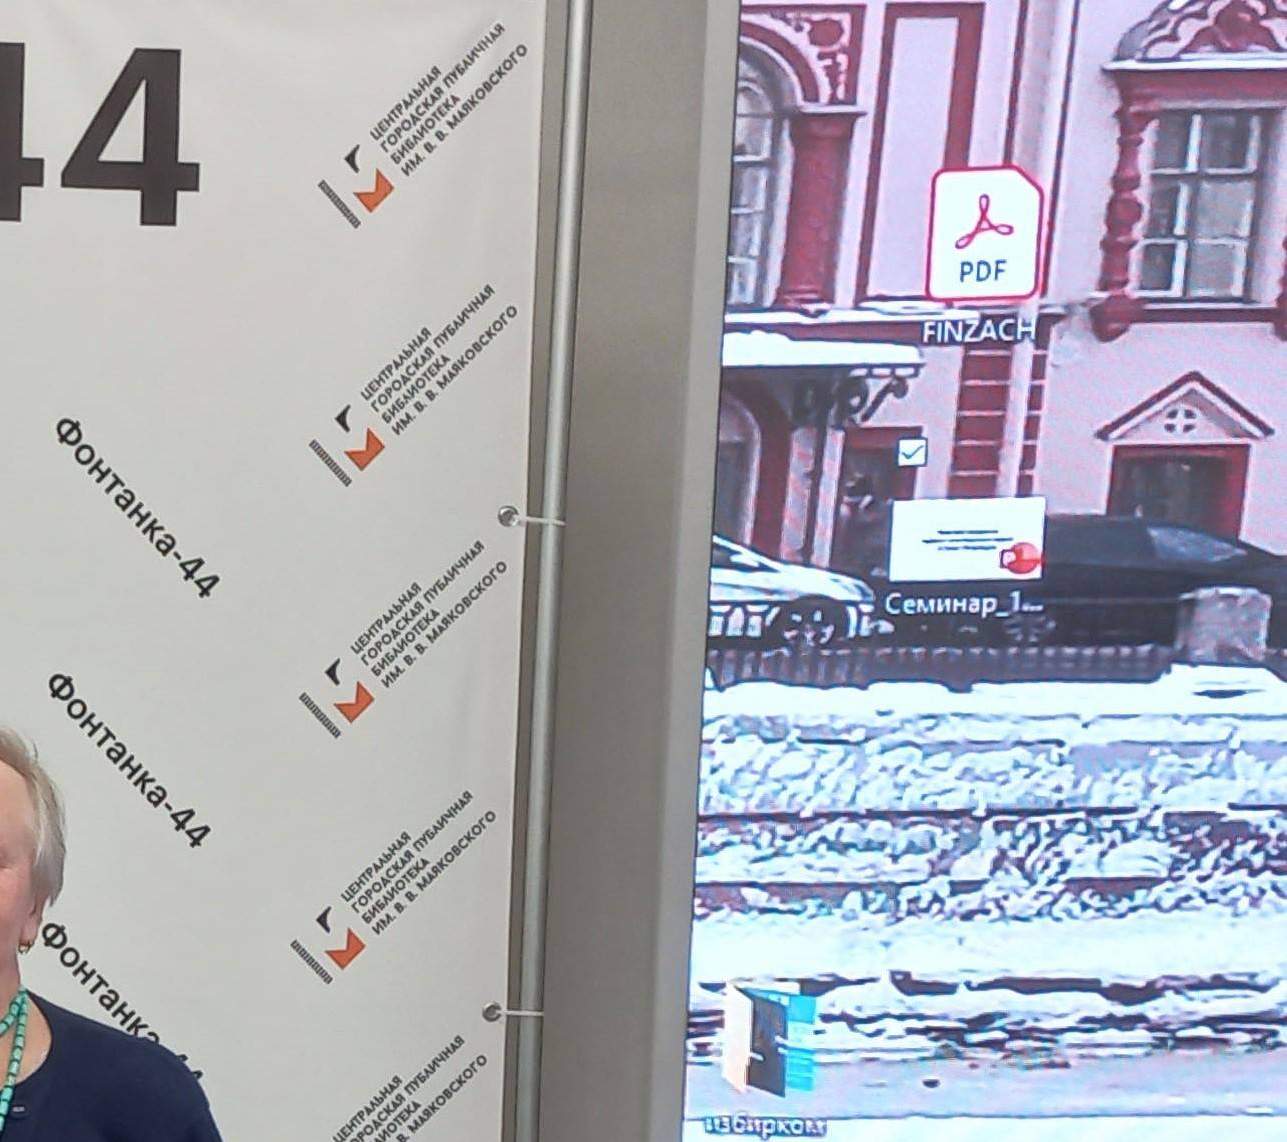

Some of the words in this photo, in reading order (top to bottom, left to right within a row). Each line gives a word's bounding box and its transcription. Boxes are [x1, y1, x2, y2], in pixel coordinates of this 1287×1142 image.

[370, 66, 441, 140] ЦЕНТРАЛЬНАЯ
[381, 87, 444, 152] ГОРОДСКАЯ
[443, 24, 505, 88] ПУБЛИЧНАЯ
[401, 153, 425, 176] ИМ.
[447, 45, 527, 129] МАЯКОВСКОГО
[391, 95, 460, 164] БИБЛИОТЕКА
[959, 259, 1008, 284] PDF
[361, 328, 431, 400] ЦЕНТРАЛЬНАЯ
[371, 347, 435, 412] ГОРОДСКАЯ
[433, 285, 494, 348] ПУБЛИЧНАЯ
[922, 318, 1037, 345] FINZACH
[382, 355, 450, 423] БИБЛИОТЕКА
[392, 412, 416, 435] ИМ.
[436, 306, 517, 389] МАЯКОВСКОГО
[56, 417, 221, 598] Фонтанка-44
[350, 583, 421, 654] ЦЕНТРАЛЬНАЯ
[361, 601, 424, 666] ГОРОДСКАЯ
[423, 541, 484, 603] ПУБЛИЧНАЯ
[381, 666, 405, 688] ИМ.
[426, 562, 507, 644] МАЯКОВСКОГО
[371, 609, 440, 676] БИБЛИОТЕКА
[48, 673, 212, 848] Фонтанка-44
[341, 832, 411, 902] ЦЕНТРАЛЬНАЯ
[351, 850, 414, 913] ГОРОДСКАЯ
[413, 791, 473, 852] ПУБЛИЧНАЯ
[372, 913, 396, 935] ИМ.
[416, 811, 496, 891] МАЯКОВСКОГО
[362, 858, 430, 924] БИБЛИОТЕКА
[404, 1035, 465, 1095] ПУБЛИЧНАЯ
[407, 1055, 487, 1133] МАЯКОВСКОГО
